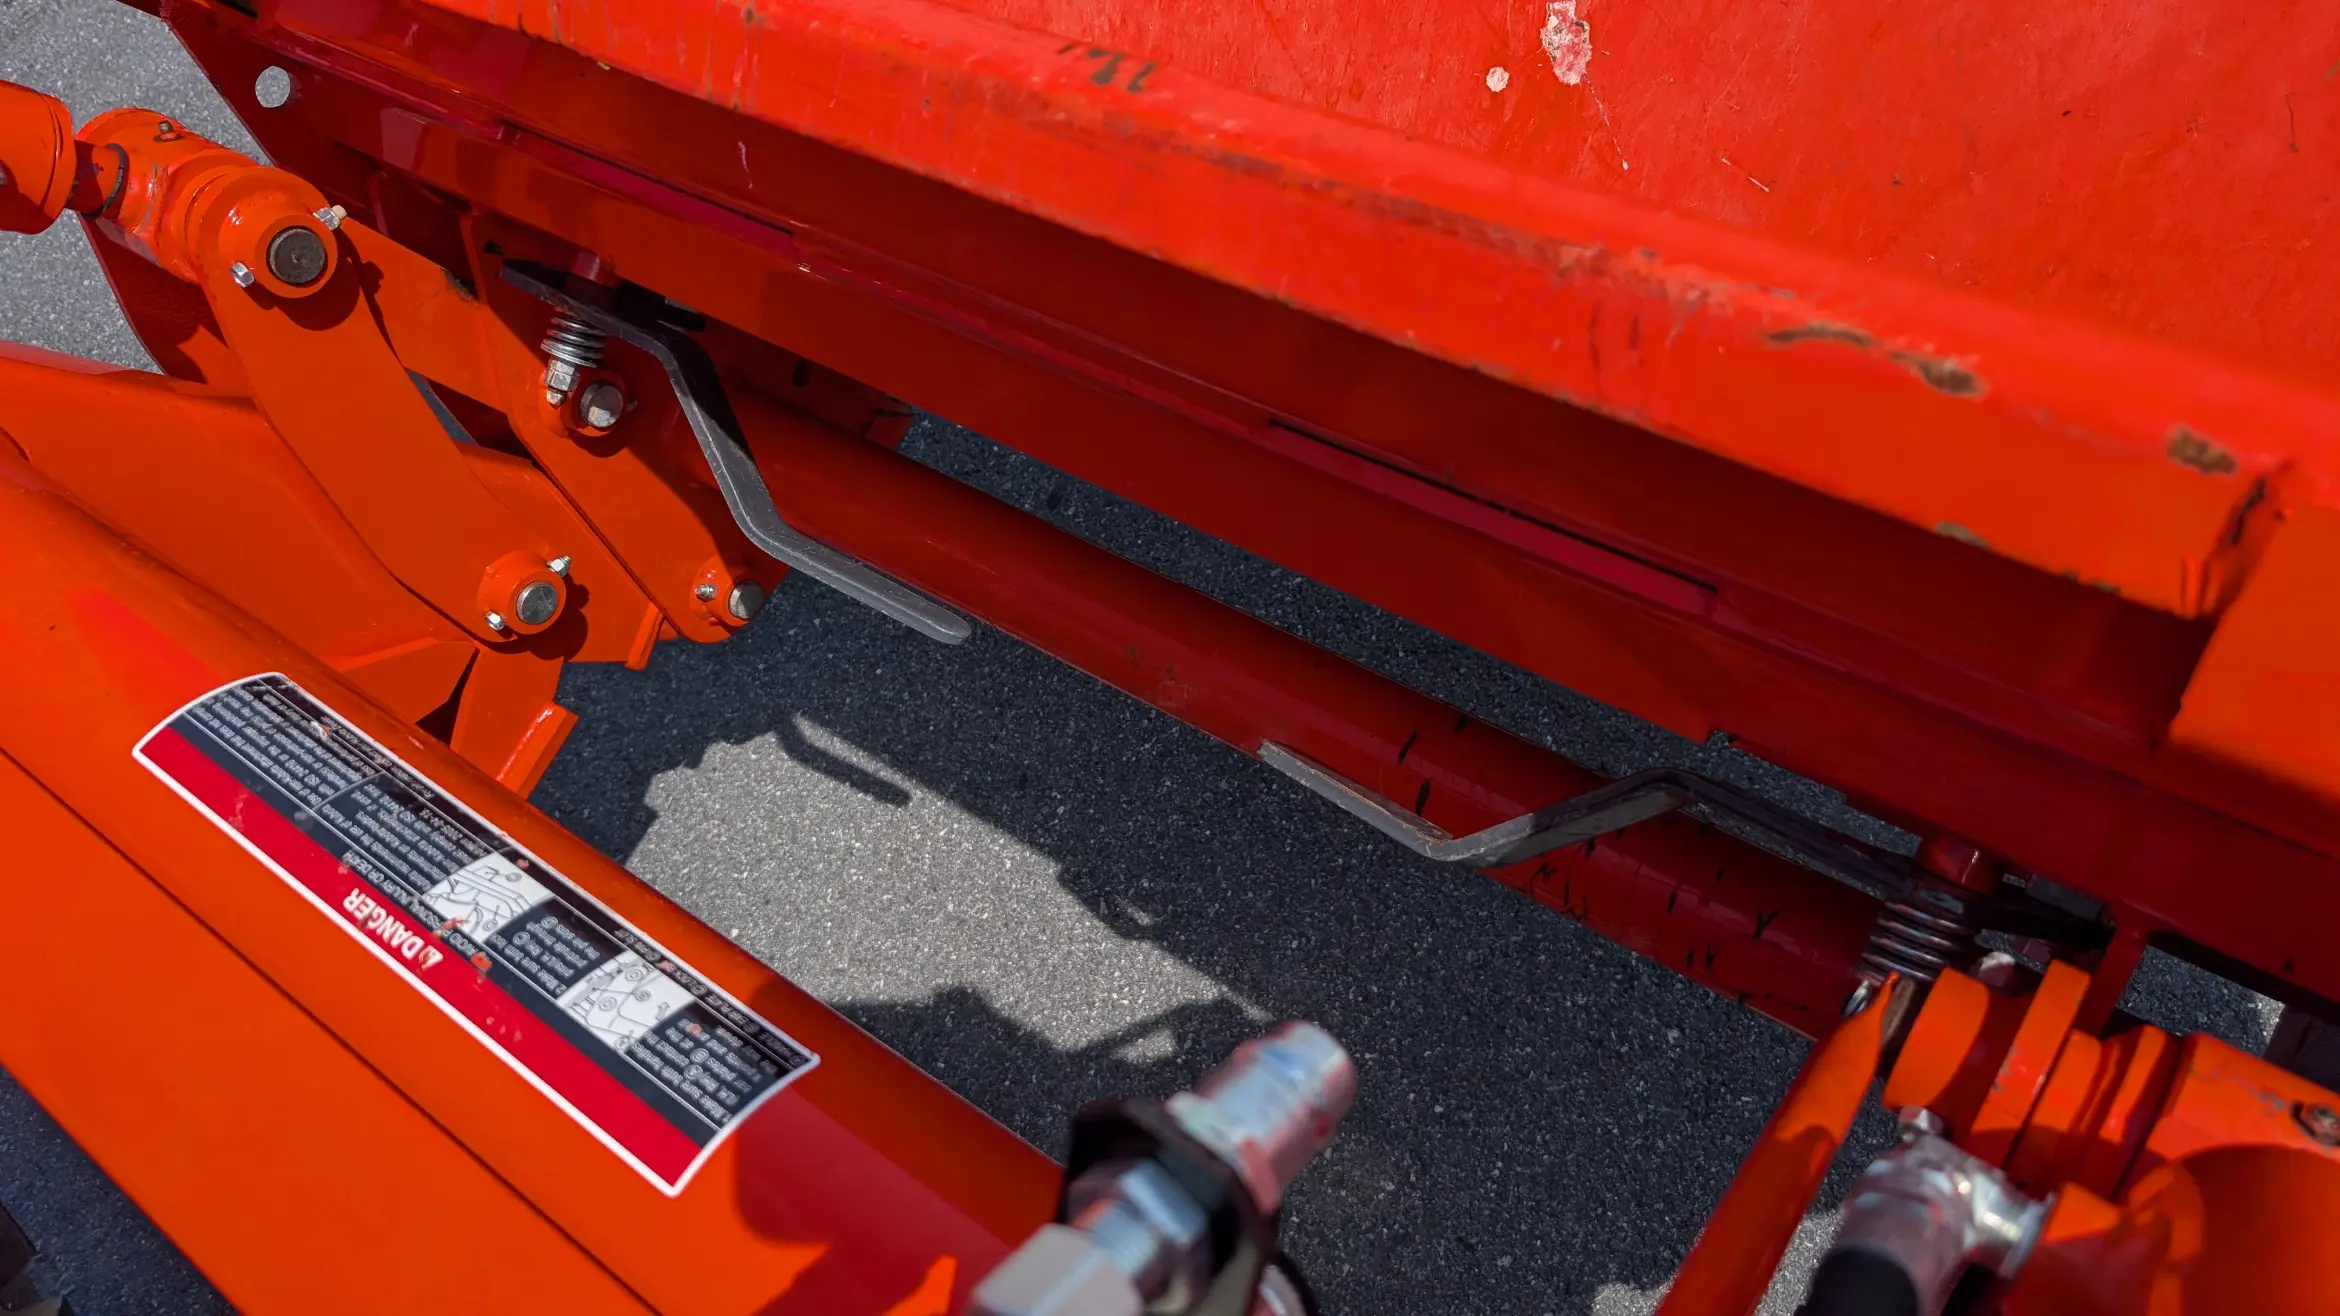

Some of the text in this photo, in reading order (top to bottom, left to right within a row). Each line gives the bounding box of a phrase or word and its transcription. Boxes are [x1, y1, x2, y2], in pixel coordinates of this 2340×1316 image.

[343, 850, 372, 872] DEATH
[367, 868, 386, 884] OR
[342, 887, 425, 961] DANGER
[409, 902, 453, 936] PRSONAL
[449, 933, 478, 956] AVOID
